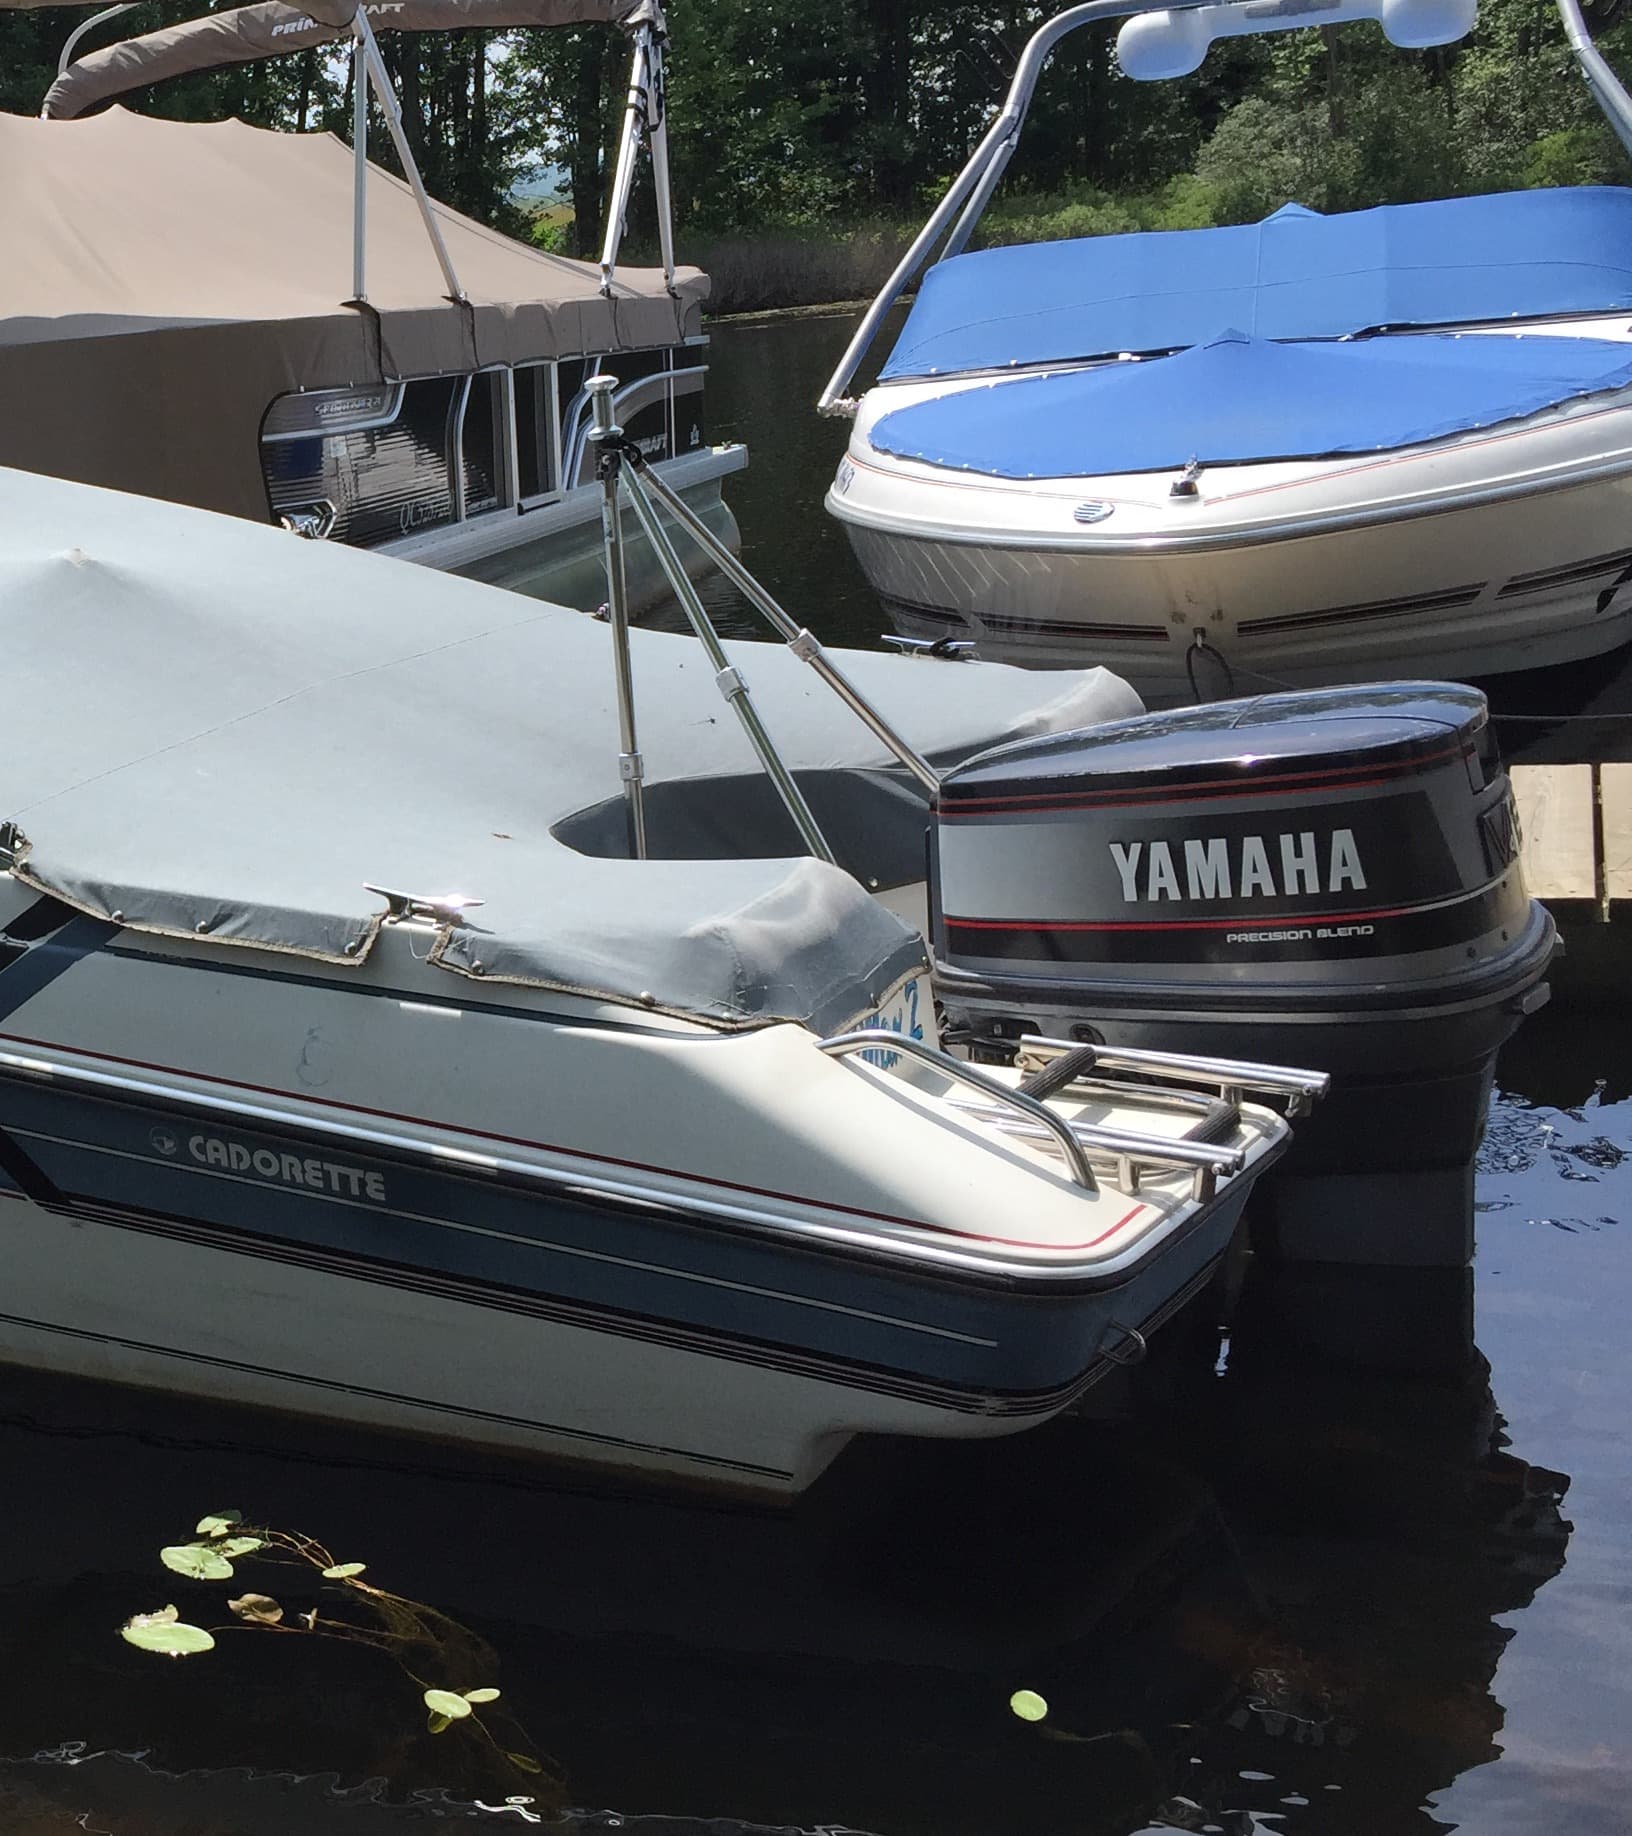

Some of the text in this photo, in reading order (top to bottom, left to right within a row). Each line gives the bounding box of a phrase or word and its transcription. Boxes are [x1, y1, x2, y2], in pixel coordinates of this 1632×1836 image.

[1108, 828, 1367, 902] YAMAHA
[1226, 924, 1374, 944] PRECISION BLEND
[188, 1135, 386, 1201] CADORETTE
